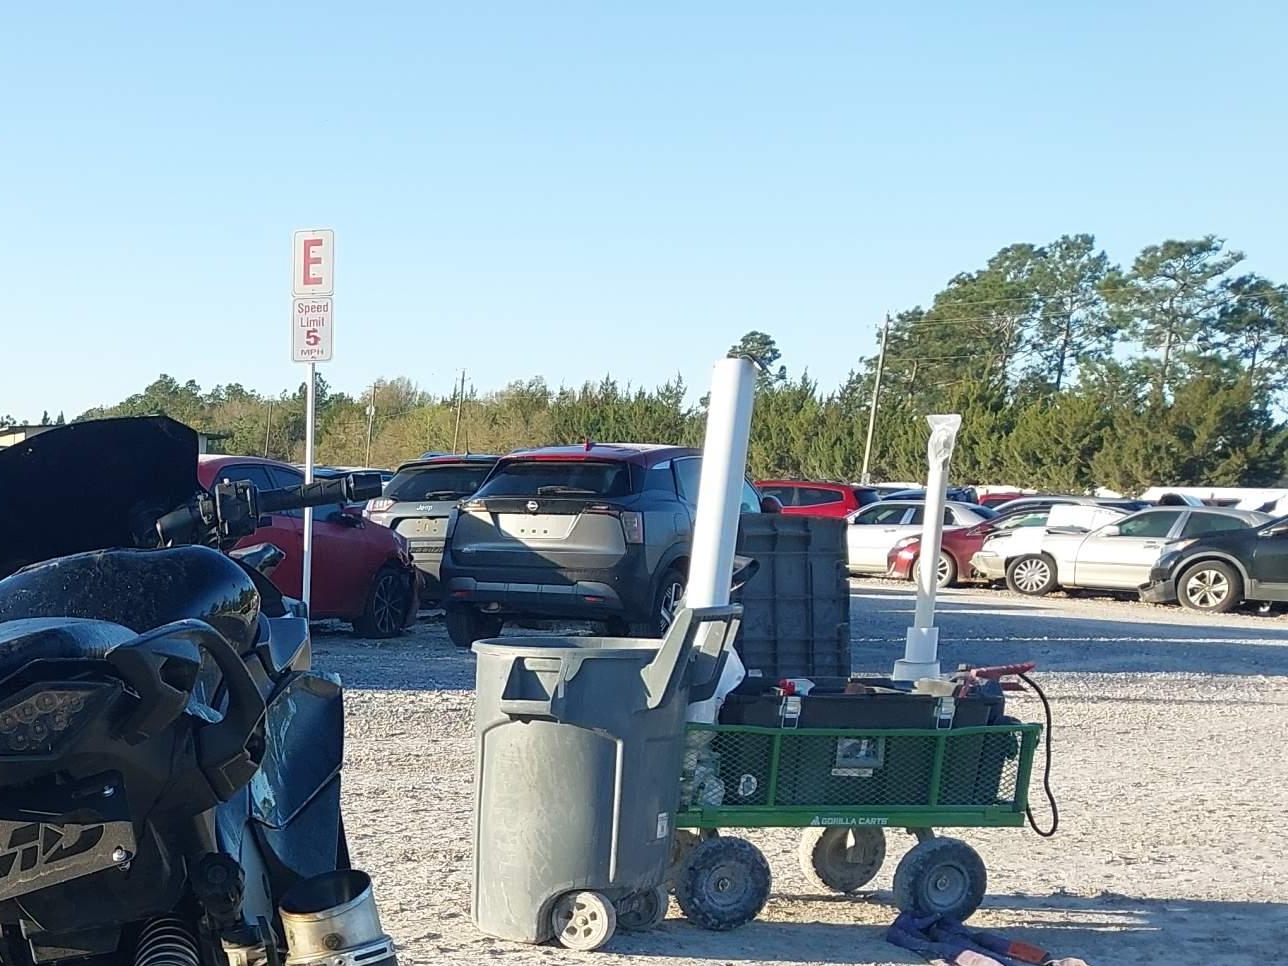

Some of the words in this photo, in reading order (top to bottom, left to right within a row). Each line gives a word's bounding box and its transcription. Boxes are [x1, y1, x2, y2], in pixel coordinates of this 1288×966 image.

[303, 238, 323, 285] E
[297, 302, 329, 315] Speed
[300, 316, 325, 328] Limit
[305, 328, 321, 346] 5
[416, 504, 433, 512] Jeep
[821, 817, 856, 825] GORILLA
[858, 817, 888, 825] CARTS
